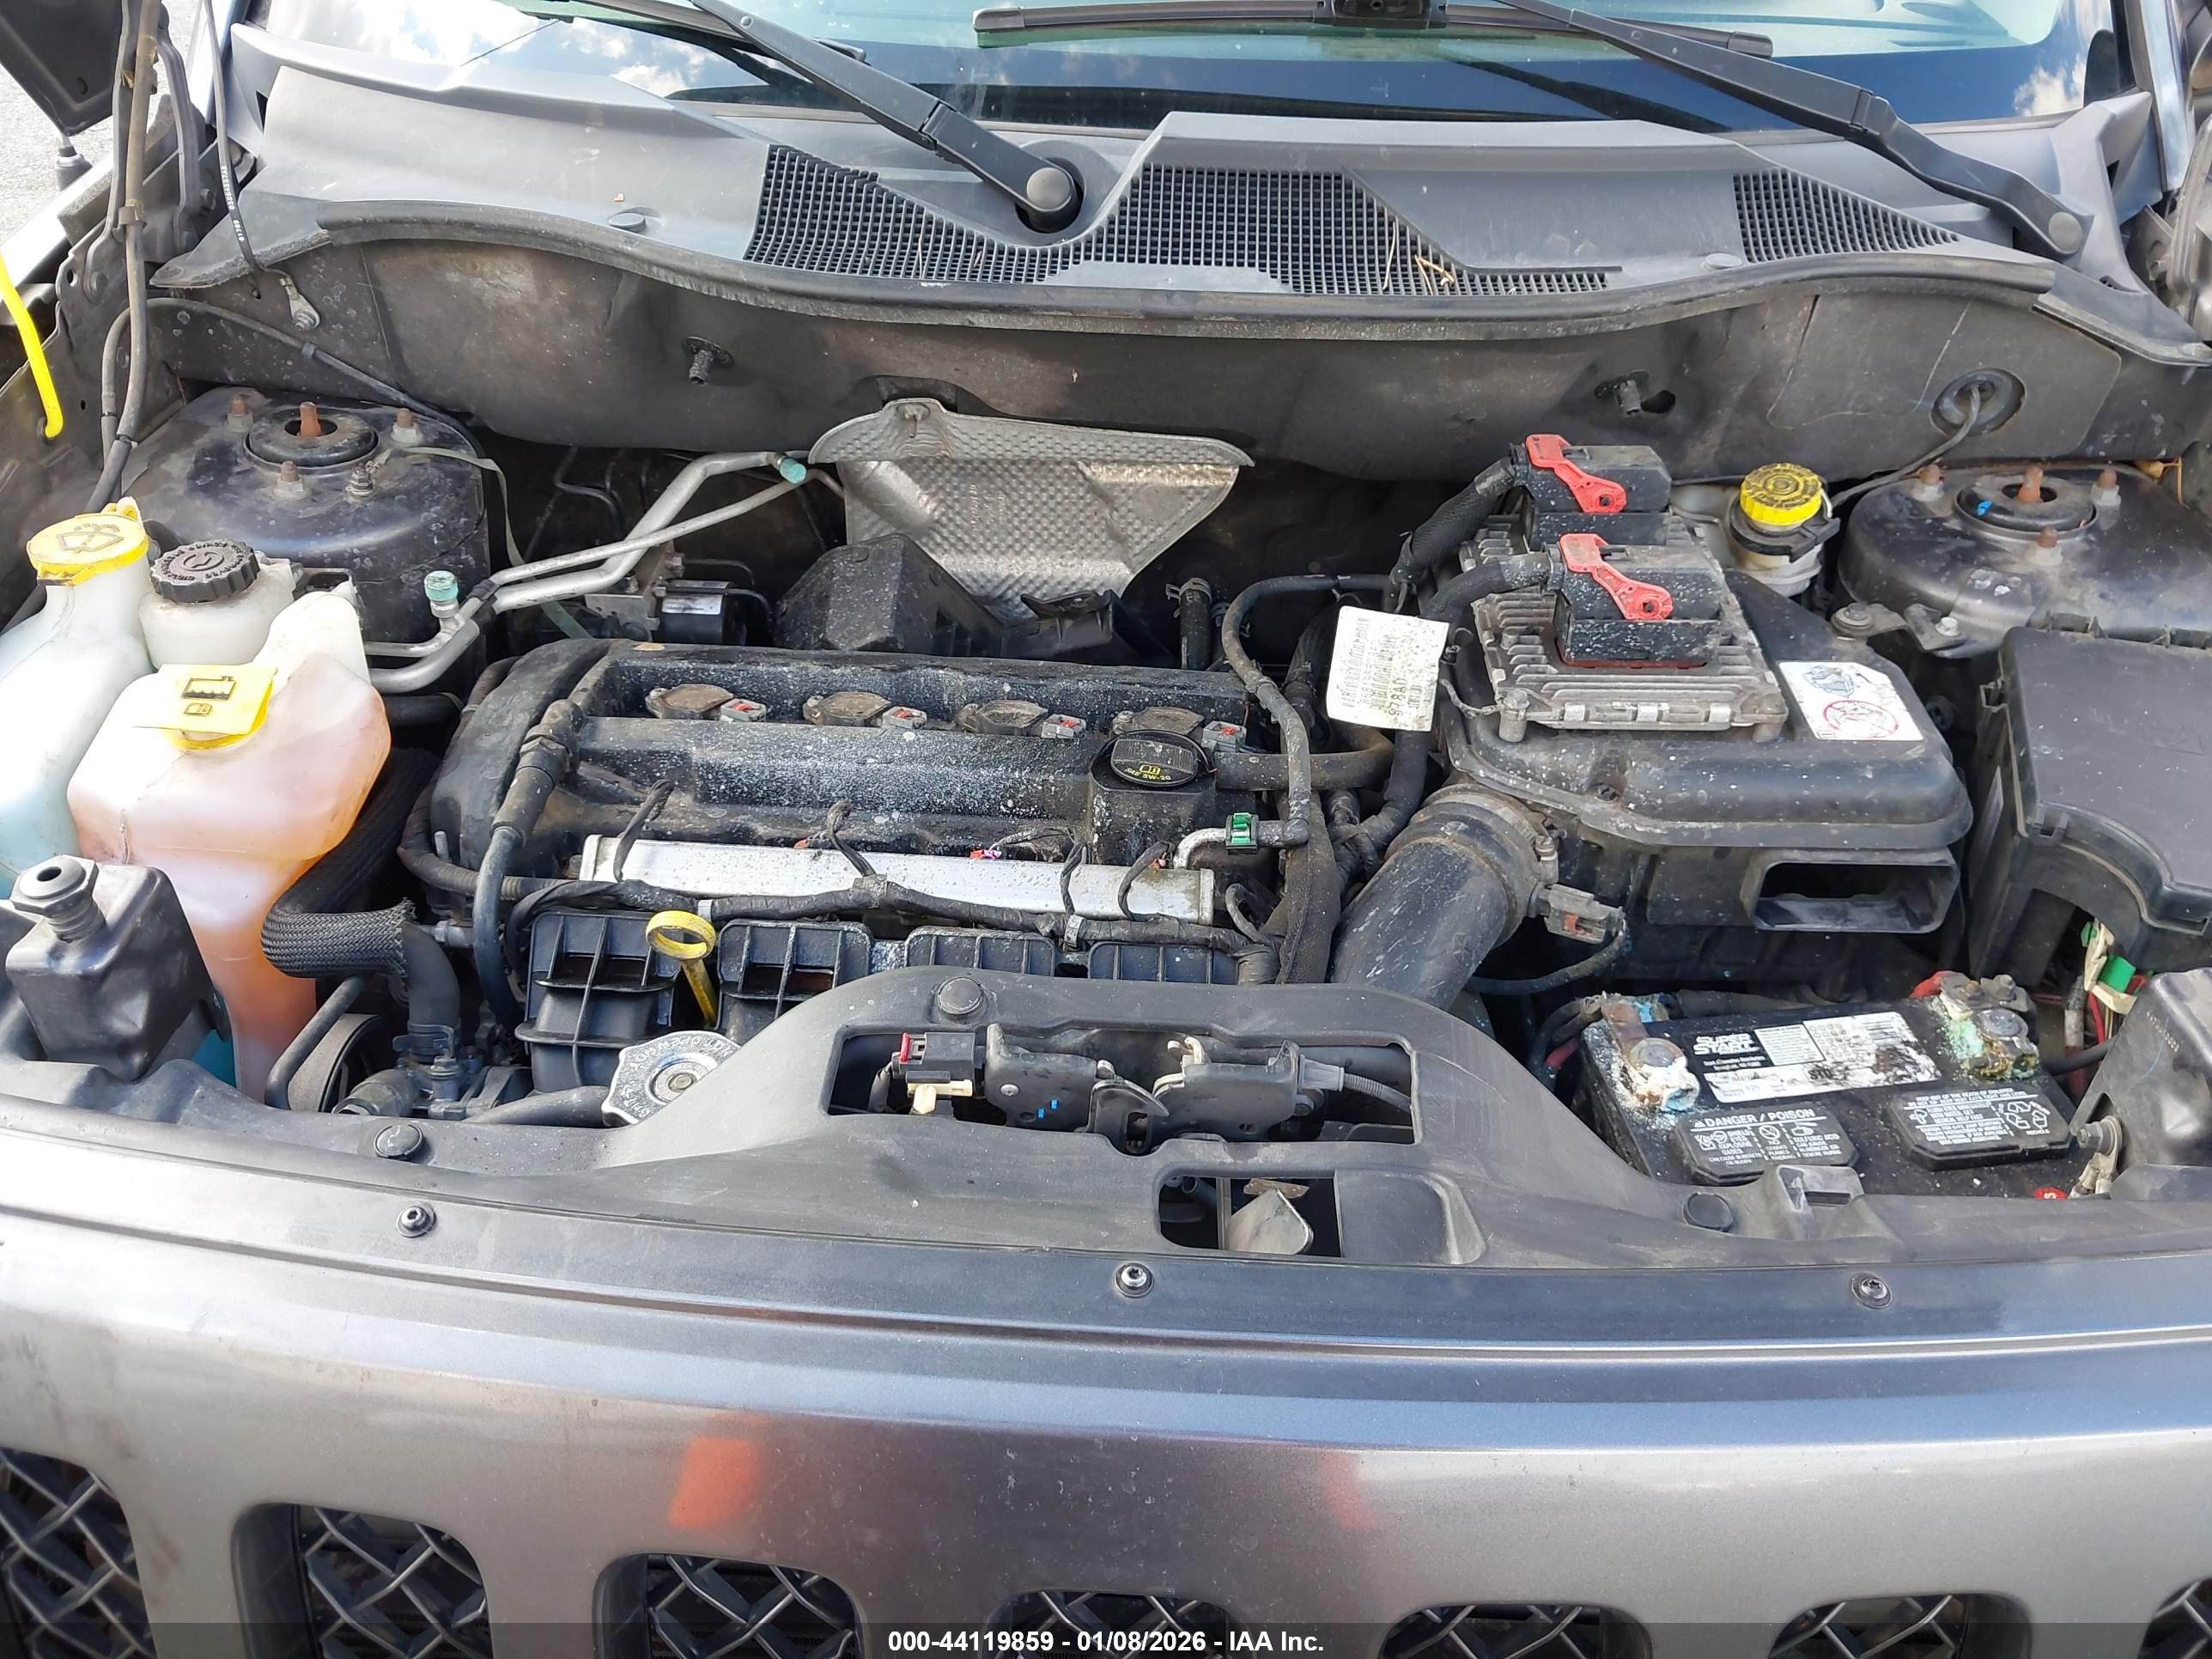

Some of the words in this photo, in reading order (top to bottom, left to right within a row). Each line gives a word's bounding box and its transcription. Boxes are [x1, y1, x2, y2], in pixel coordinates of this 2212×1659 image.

[1124, 768, 1141, 777] SAE
[1696, 1033, 1752, 1045] SUPER
[1693, 1039, 1754, 1055] START
[1705, 1115, 1759, 1127] DANGER
[1767, 1109, 1816, 1121] POISON
